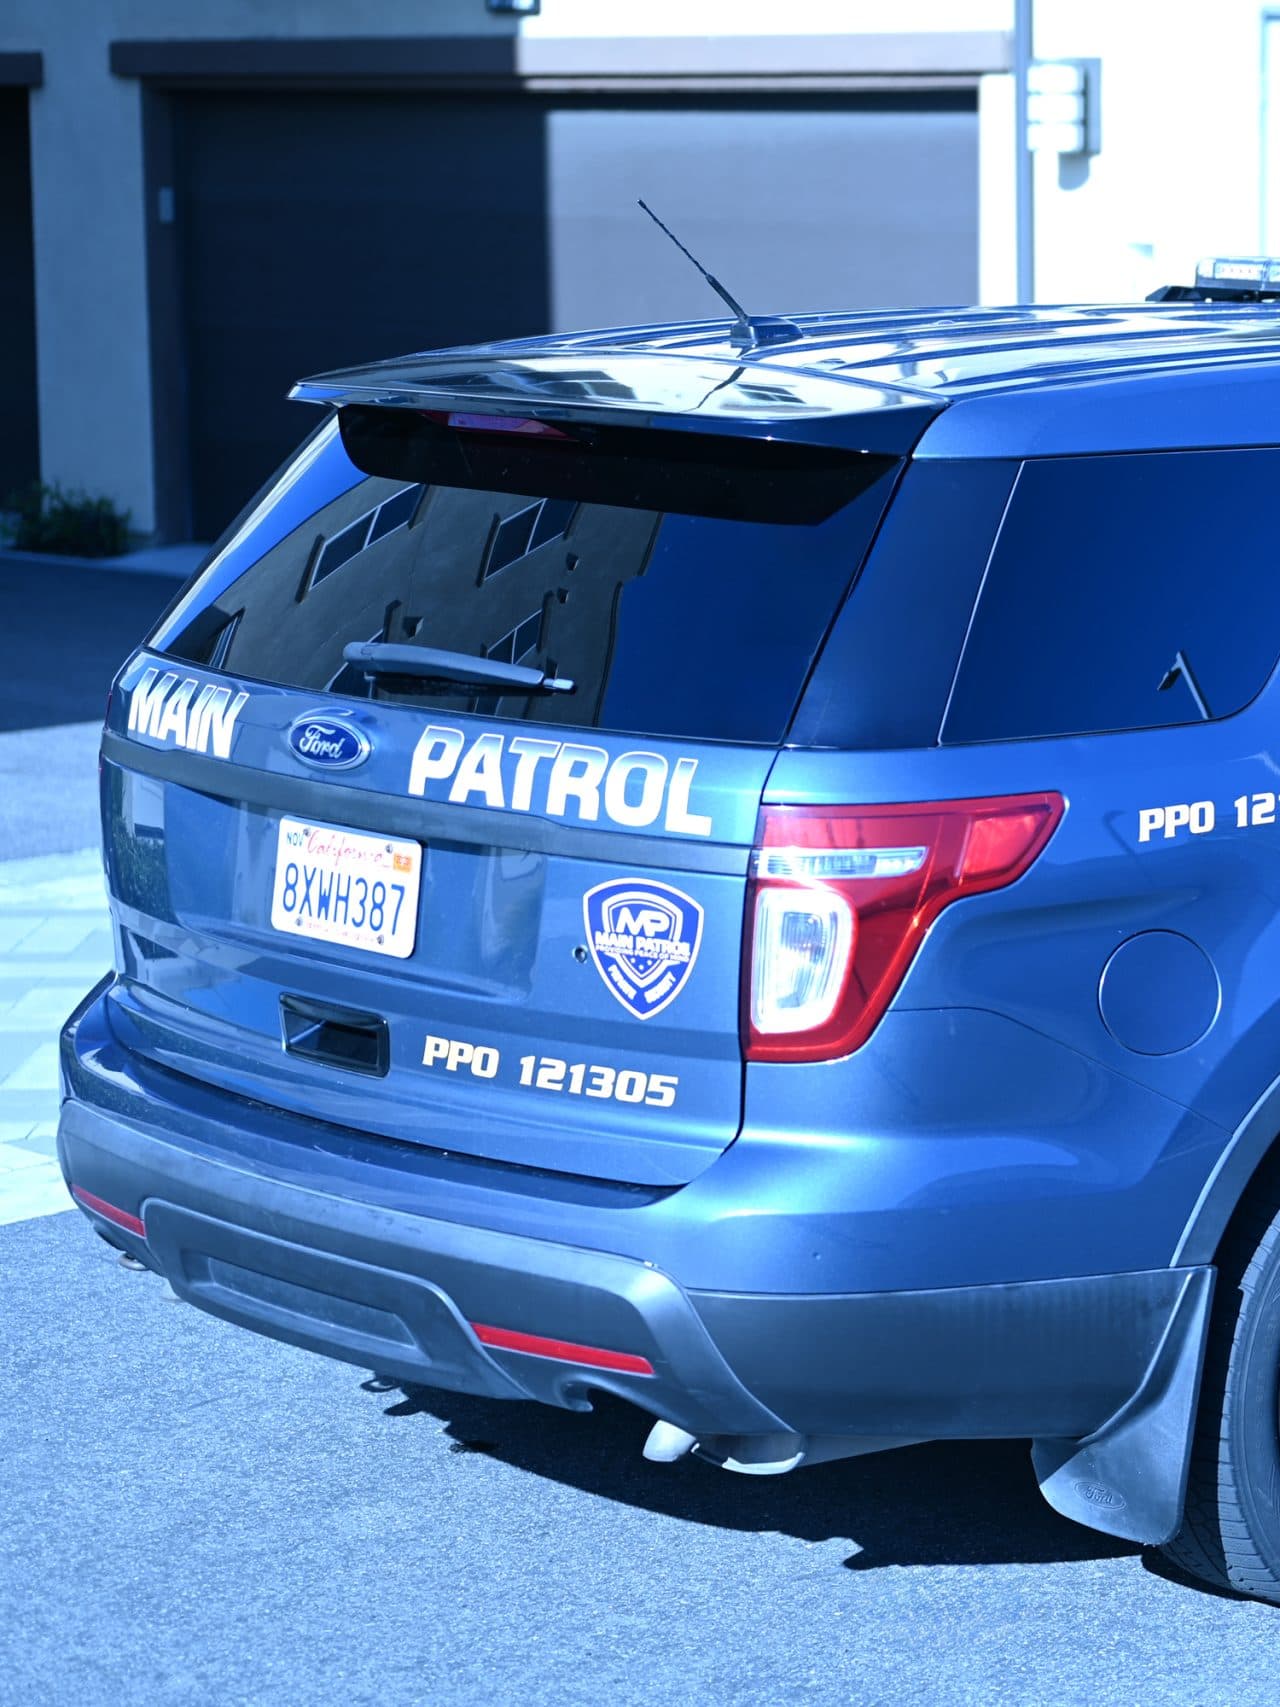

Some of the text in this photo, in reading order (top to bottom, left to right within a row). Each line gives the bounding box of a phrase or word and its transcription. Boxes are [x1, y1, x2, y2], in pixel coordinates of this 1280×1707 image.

[128, 667, 250, 759] MAIN
[299, 723, 344, 760] Ford
[408, 725, 712, 837] PATROL
[286, 831, 304, 847] NOV
[1138, 800, 1215, 843] PPO
[282, 862, 406, 936] 8XWH387
[616, 906, 670, 937] MP
[595, 930, 691, 957] MAIN PATROL
[422, 1035, 679, 1107] PPO 121305
[1085, 1485, 1114, 1505] Ford
